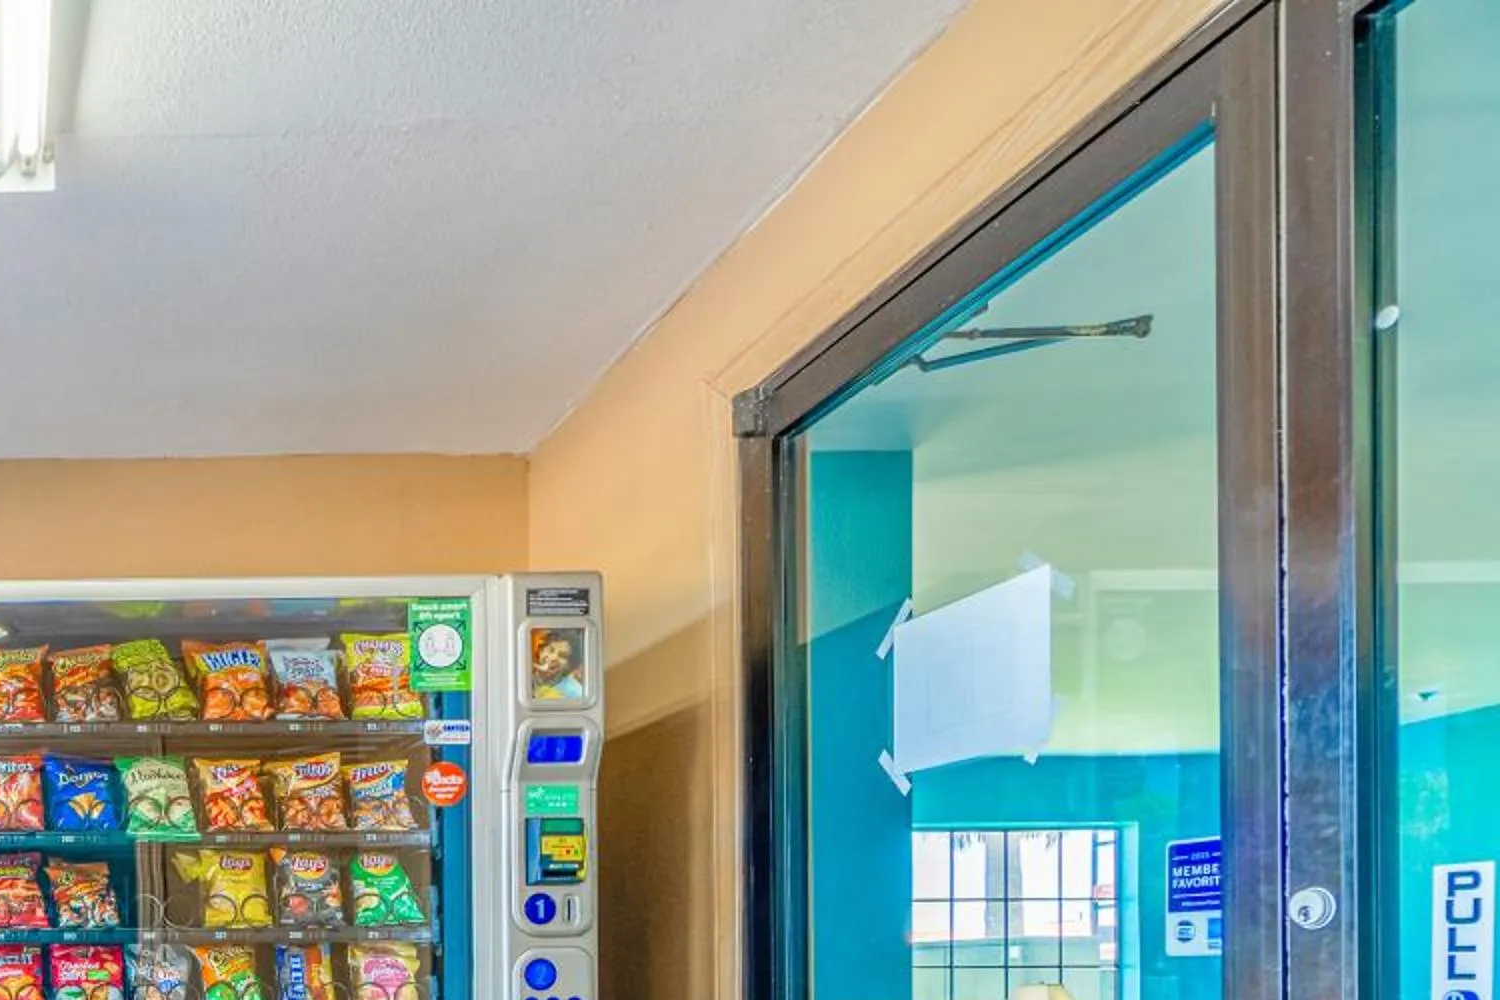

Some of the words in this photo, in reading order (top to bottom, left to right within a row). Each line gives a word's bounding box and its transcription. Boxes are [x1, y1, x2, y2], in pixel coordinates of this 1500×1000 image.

[1171, 863, 1221, 877] MEMBE
[1171, 875, 1221, 889] FAVORIT
[535, 898, 545, 919] 1
[1445, 870, 1482, 980] PULL
